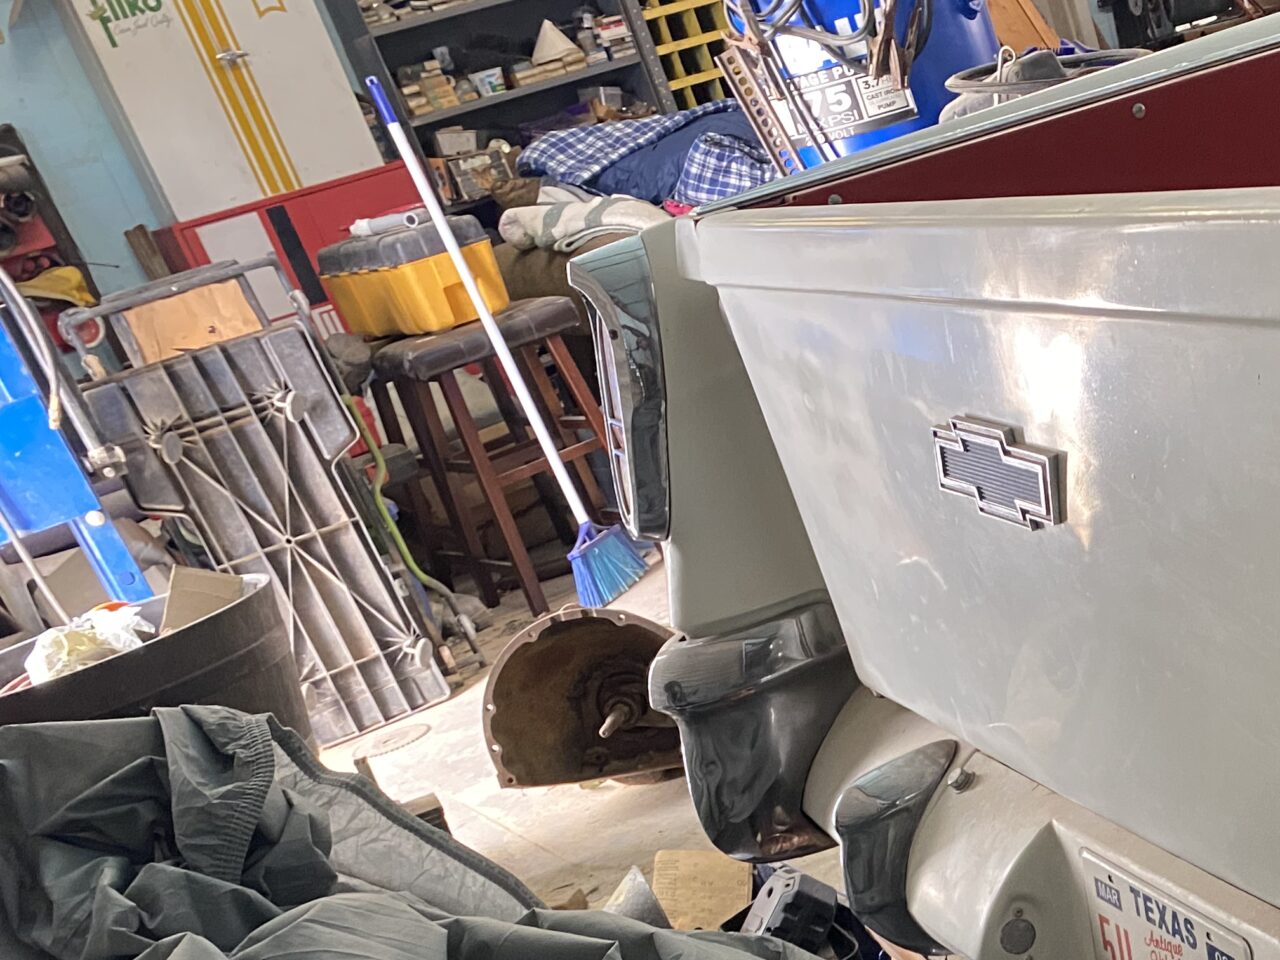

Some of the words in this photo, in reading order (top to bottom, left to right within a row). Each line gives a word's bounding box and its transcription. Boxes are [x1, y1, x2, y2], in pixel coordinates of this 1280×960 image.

[828, 109, 860, 127] PSI
[1097, 880, 1120, 908] MAR
[1129, 885, 1198, 950] TEXAS
[1144, 930, 1183, 960] Antique
